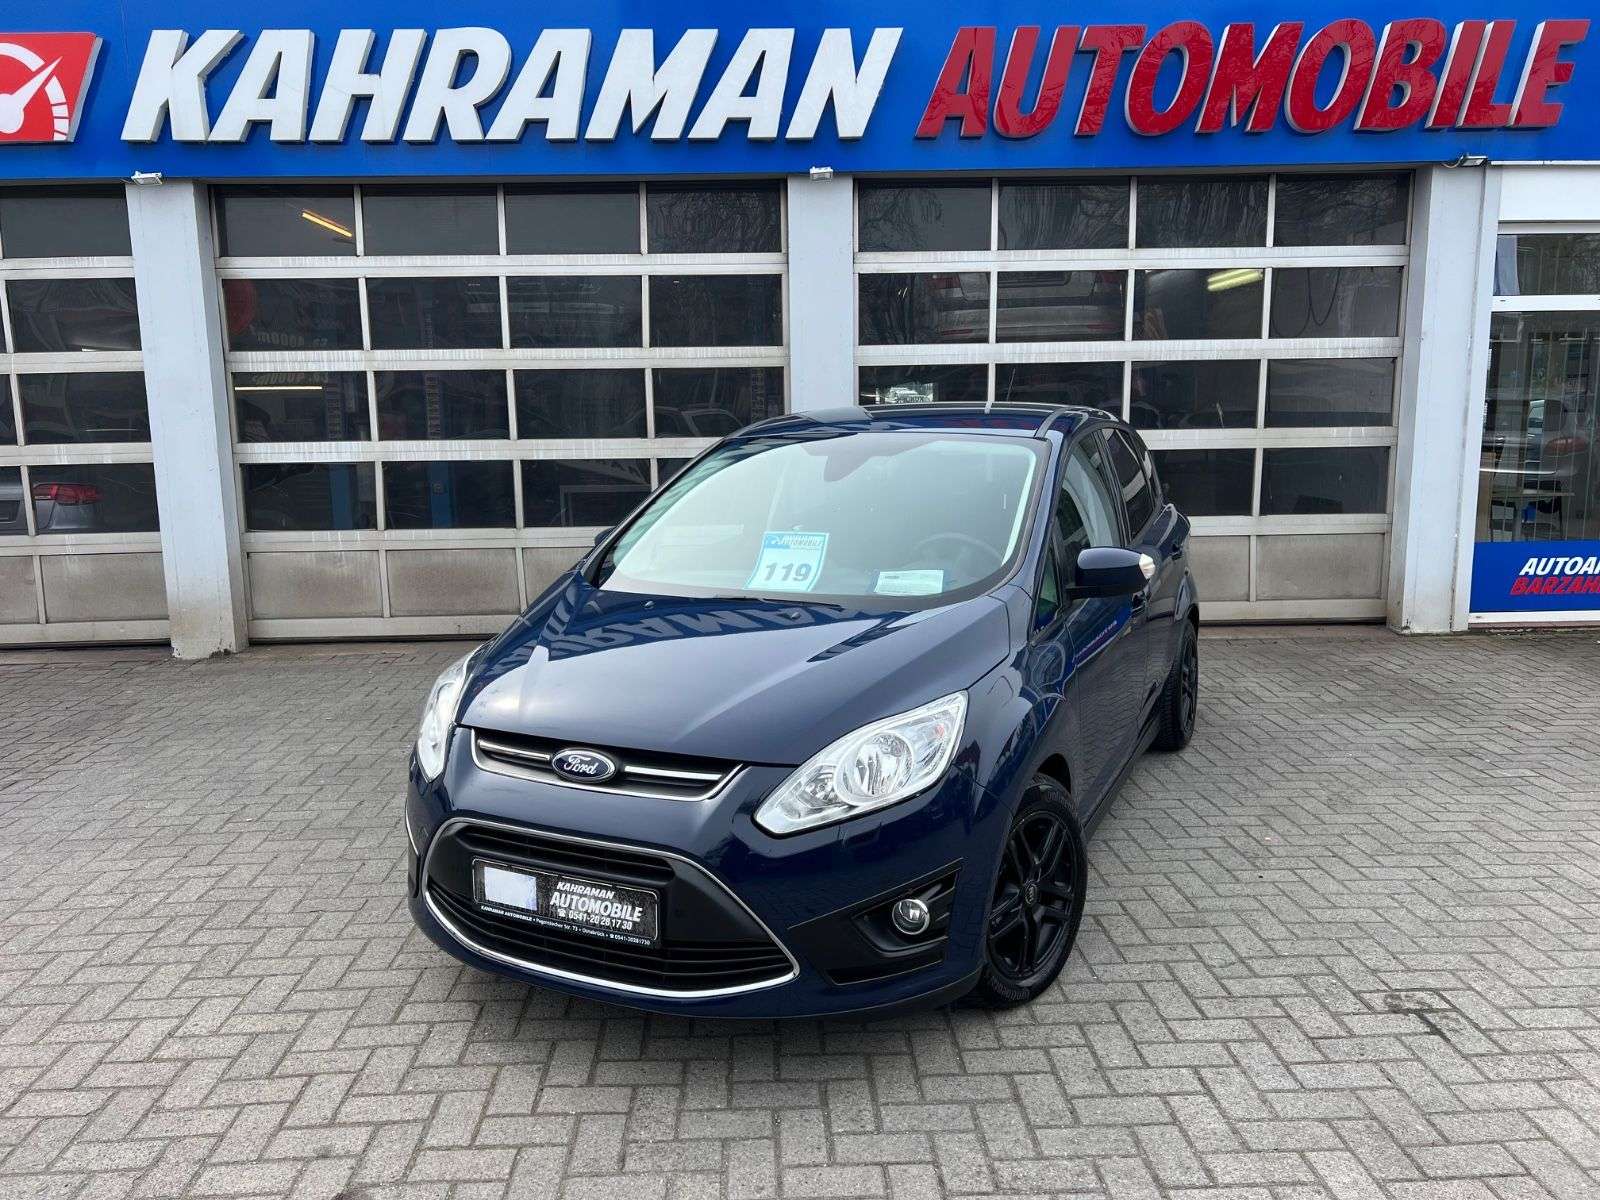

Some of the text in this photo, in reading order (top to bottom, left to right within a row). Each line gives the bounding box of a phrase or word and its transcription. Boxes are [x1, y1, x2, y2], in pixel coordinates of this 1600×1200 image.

[120, 18, 1590, 144] KAHRAMAN AUTOMOBILE
[764, 562, 812, 582] 119
[1511, 576, 1600, 595] BARZAH
[563, 754, 599, 775] Ford
[556, 881, 616, 900] KAHRAMAN
[549, 891, 643, 922] AUTOMOBILE
[568, 909, 600, 924] 0541-20
[621, 920, 633, 931] 30
